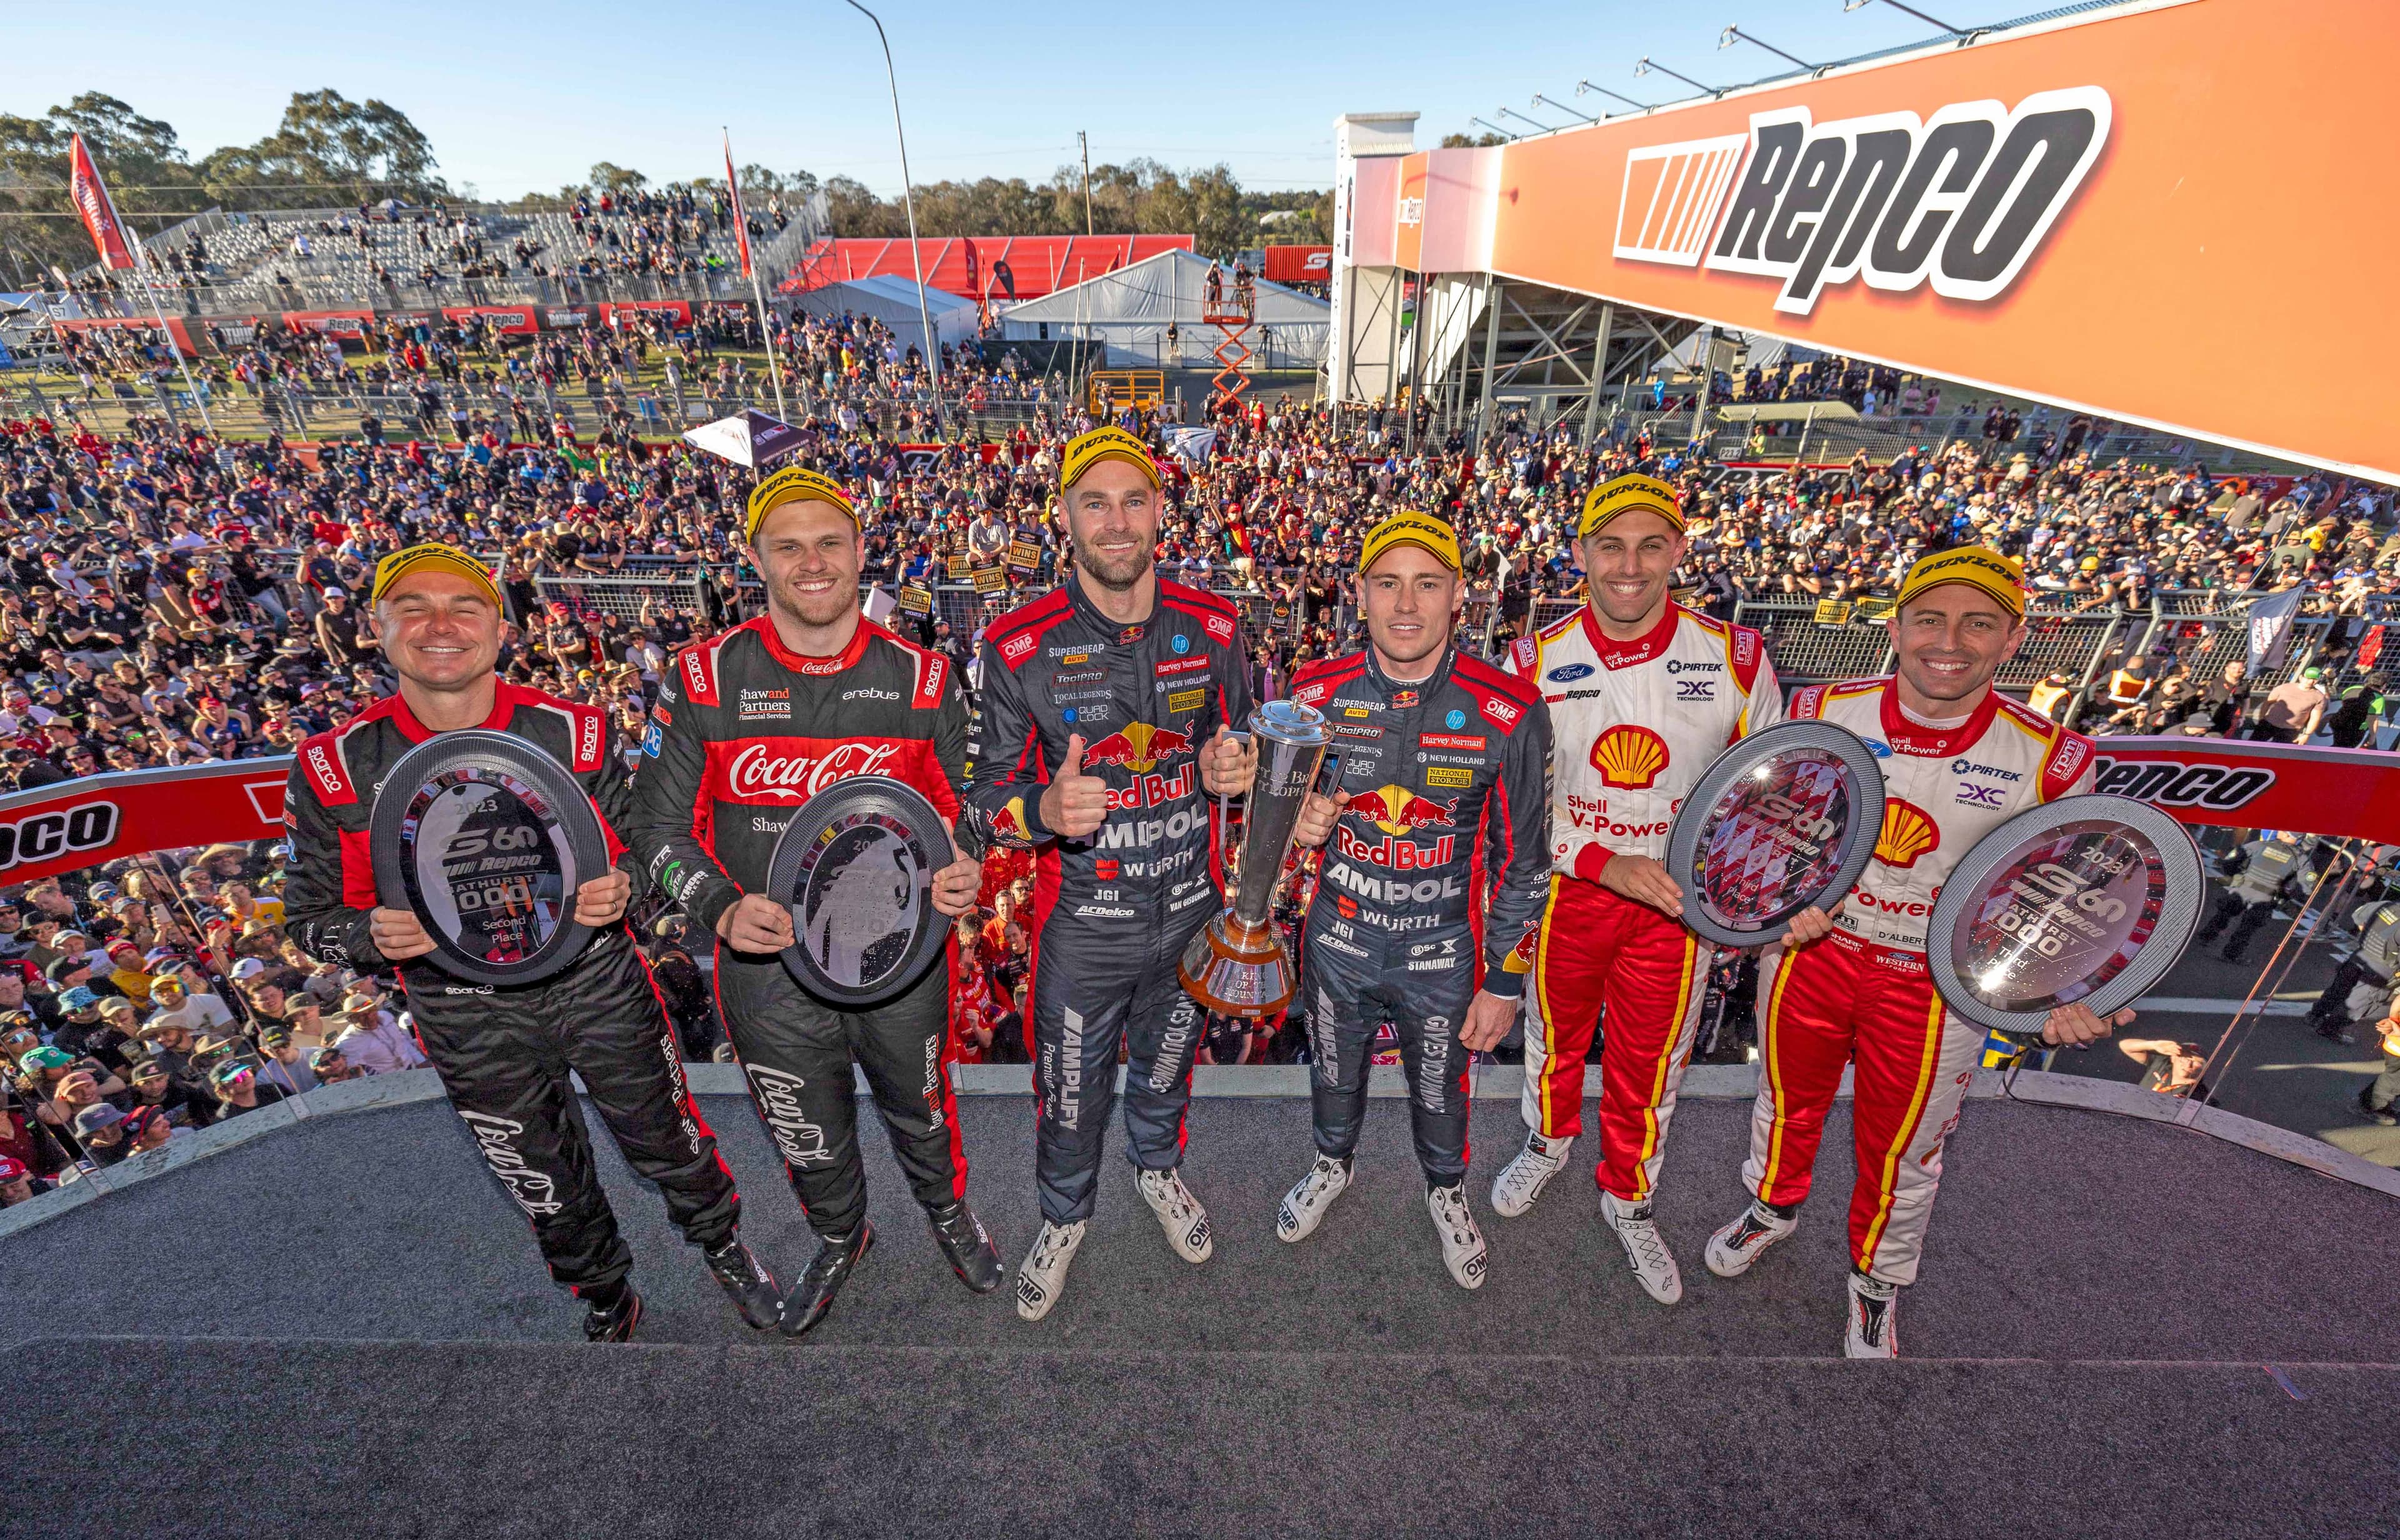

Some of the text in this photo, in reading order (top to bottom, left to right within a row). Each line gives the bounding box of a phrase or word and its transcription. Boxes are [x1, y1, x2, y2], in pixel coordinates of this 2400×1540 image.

[1711, 105, 2099, 300] Repco
[1071, 433, 1148, 460] DUNLOP
[1719, 449, 1741, 459] P23.2
[756, 473, 839, 506] DUNLOP
[1369, 520, 1450, 548] DUNLOP
[1010, 556, 1038, 567] BATHURST
[1011, 548, 1038, 559] WINS
[385, 546, 490, 579] DUNLOP
[951, 560, 969, 570] WIN
[1915, 556, 2018, 582] DUNLOP
[976, 572, 1002, 586] WINS
[977, 581, 1004, 594] BATHURST
[901, 601, 928, 611] BATHURST
[902, 593, 929, 605] WINS
[1821, 606, 1846, 616] WINS
[1208, 618, 1232, 635] OMP
[1004, 636, 1034, 657] OMP
[1049, 643, 1104, 658] SUPERCHEAP
[1158, 656, 1208, 673] Harvey Norman
[1605, 651, 1621, 662] Shell
[1608, 651, 1649, 669] V-Power
[684, 652, 708, 693] sparco
[801, 658, 844, 674] Coca-Cola
[1556, 665, 1585, 681] Ford
[1682, 662, 1723, 672] PIRTEK
[924, 659, 942, 699] sparco
[1056, 671, 1103, 683] ToolPRO
[1167, 674, 1211, 689] NEW HOLLAND
[842, 687, 900, 701] erebus
[1054, 689, 1112, 704] LOCAL LEGENDS
[1170, 690, 1204, 702] NATIONAL
[1299, 686, 1324, 701] OMP
[1565, 689, 1601, 701] Repco
[1677, 681, 1715, 696] DXC
[739, 700, 791, 712] Partners
[1079, 704, 1108, 714] QUAD
[1172, 698, 1203, 710] STORAGE
[1332, 698, 1386, 712] SUPERCHEAP
[1486, 700, 1516, 721] OMP
[1079, 712, 1109, 722] LOCK
[2019, 712, 2047, 729] Repco
[581, 715, 599, 762] sparco
[1334, 726, 1380, 738] ToolPRO
[1422, 736, 1482, 748] Harvey Norman
[1891, 744, 1942, 756] V-Power
[1351, 744, 1382, 758] LEGENDS
[2052, 739, 2078, 774] rpm
[1346, 758, 1375, 769] QUAD
[1429, 754, 1485, 765] NEW HOLLAND
[2062, 742, 2086, 780] RACEWEAR
[307, 745, 342, 794] sparco
[729, 742, 901, 799] Coca-Cola
[1346, 766, 1375, 778] LOCK
[1429, 769, 1470, 777] NATIONAL
[1970, 764, 2024, 782] PIRTEK
[1104, 761, 1195, 811] ed Bull
[1258, 779, 1305, 797] TROPH
[1430, 776, 1469, 784] STORAGE
[1956, 781, 2006, 806] DXC
[455, 799, 498, 814] 2023
[1566, 794, 1607, 813] Shell
[1954, 798, 2001, 812] TECHNOLOGY
[1568, 810, 1672, 836] V-Powe
[1338, 824, 1456, 871] Red Bull
[1770, 826, 1821, 856] Repco
[479, 854, 542, 872] Repco
[1124, 847, 1194, 878] WÜRTH
[2080, 846, 2124, 875] 2023
[1326, 862, 1462, 904] AMPOL
[1734, 875, 1759, 892] Third
[1094, 889, 1119, 901] JGI
[1169, 886, 1211, 912] VAN GISBERGEN
[1727, 886, 1751, 904] Place
[1076, 905, 1135, 918] ACDelco
[2042, 899, 2107, 938] Repco
[482, 915, 526, 931] Second
[1362, 909, 1440, 931] WÜRTH
[1999, 898, 2080, 946] BATHURST
[492, 930, 524, 944] Place
[1331, 920, 1353, 939] JGI
[1317, 933, 1369, 957] ACDelco
[1408, 958, 1457, 971] STANAWAY
[1876, 955, 1926, 972] WESTERN
[1889, 964, 1907, 972] FORD
[445, 983, 495, 996] sparco
[1318, 1010, 1339, 1088] AMPLIFY
[1059, 1031, 1084, 1131] AMPLIFY
